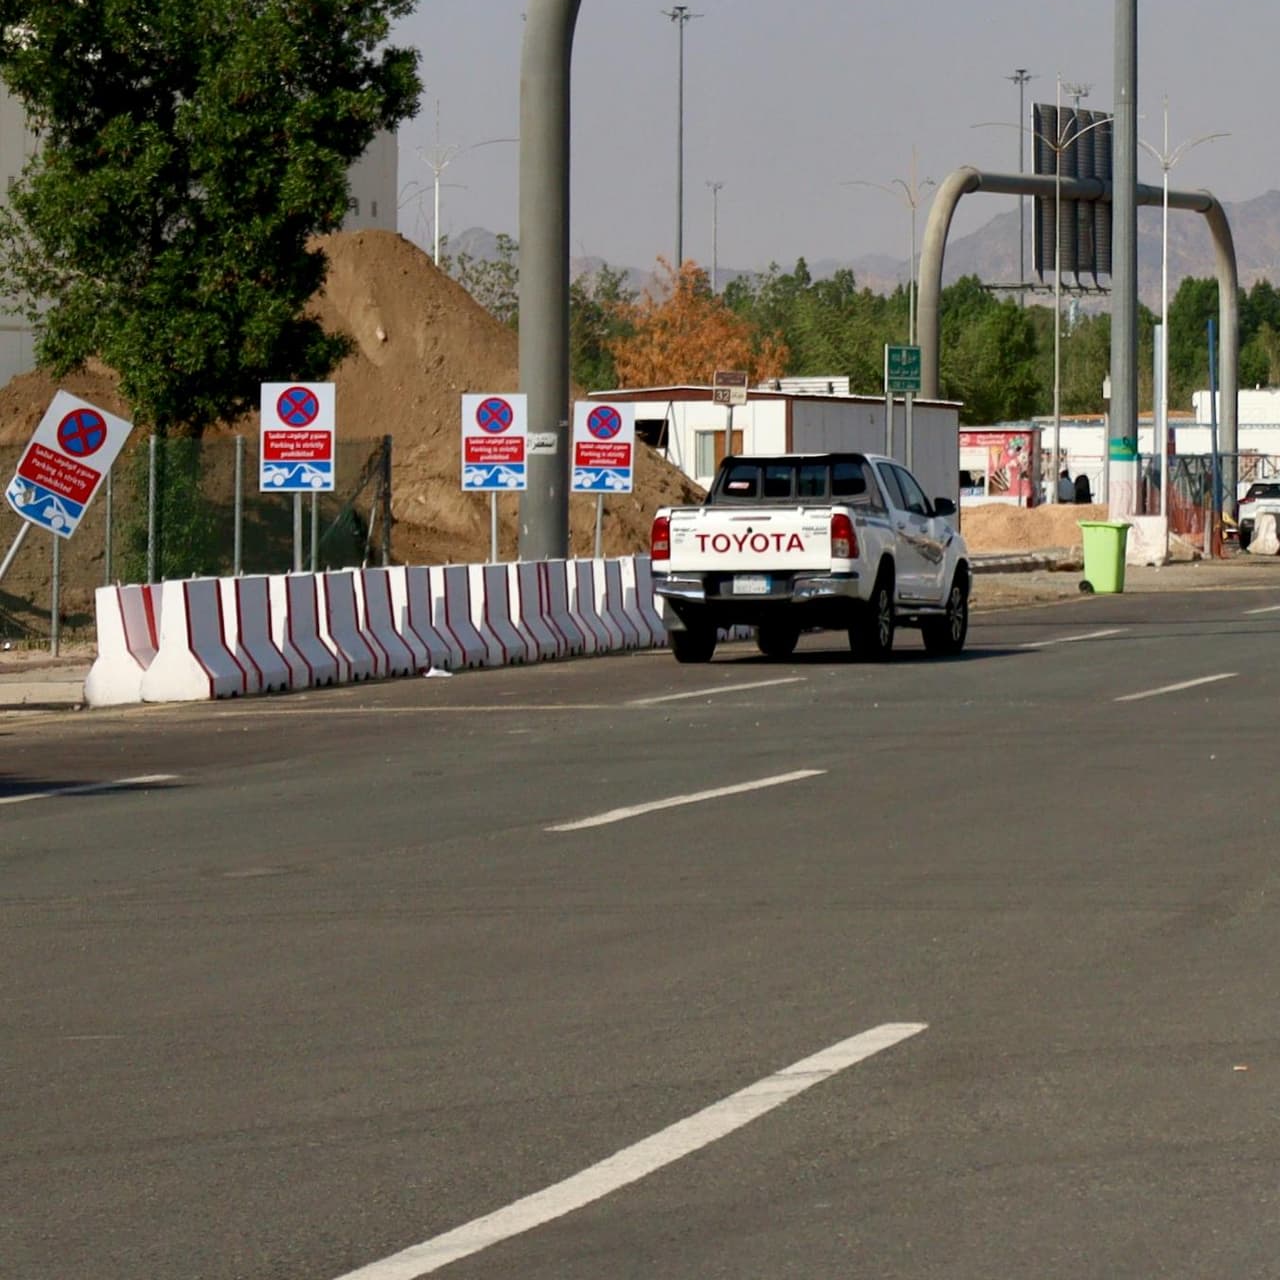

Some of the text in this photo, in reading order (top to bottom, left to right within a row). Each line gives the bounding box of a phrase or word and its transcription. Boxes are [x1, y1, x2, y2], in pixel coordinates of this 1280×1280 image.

[716, 391, 730, 401] 32
[270, 441, 294, 450] Parking
[32, 457, 57, 476] Parking
[695, 532, 806, 553] TOYOTA
